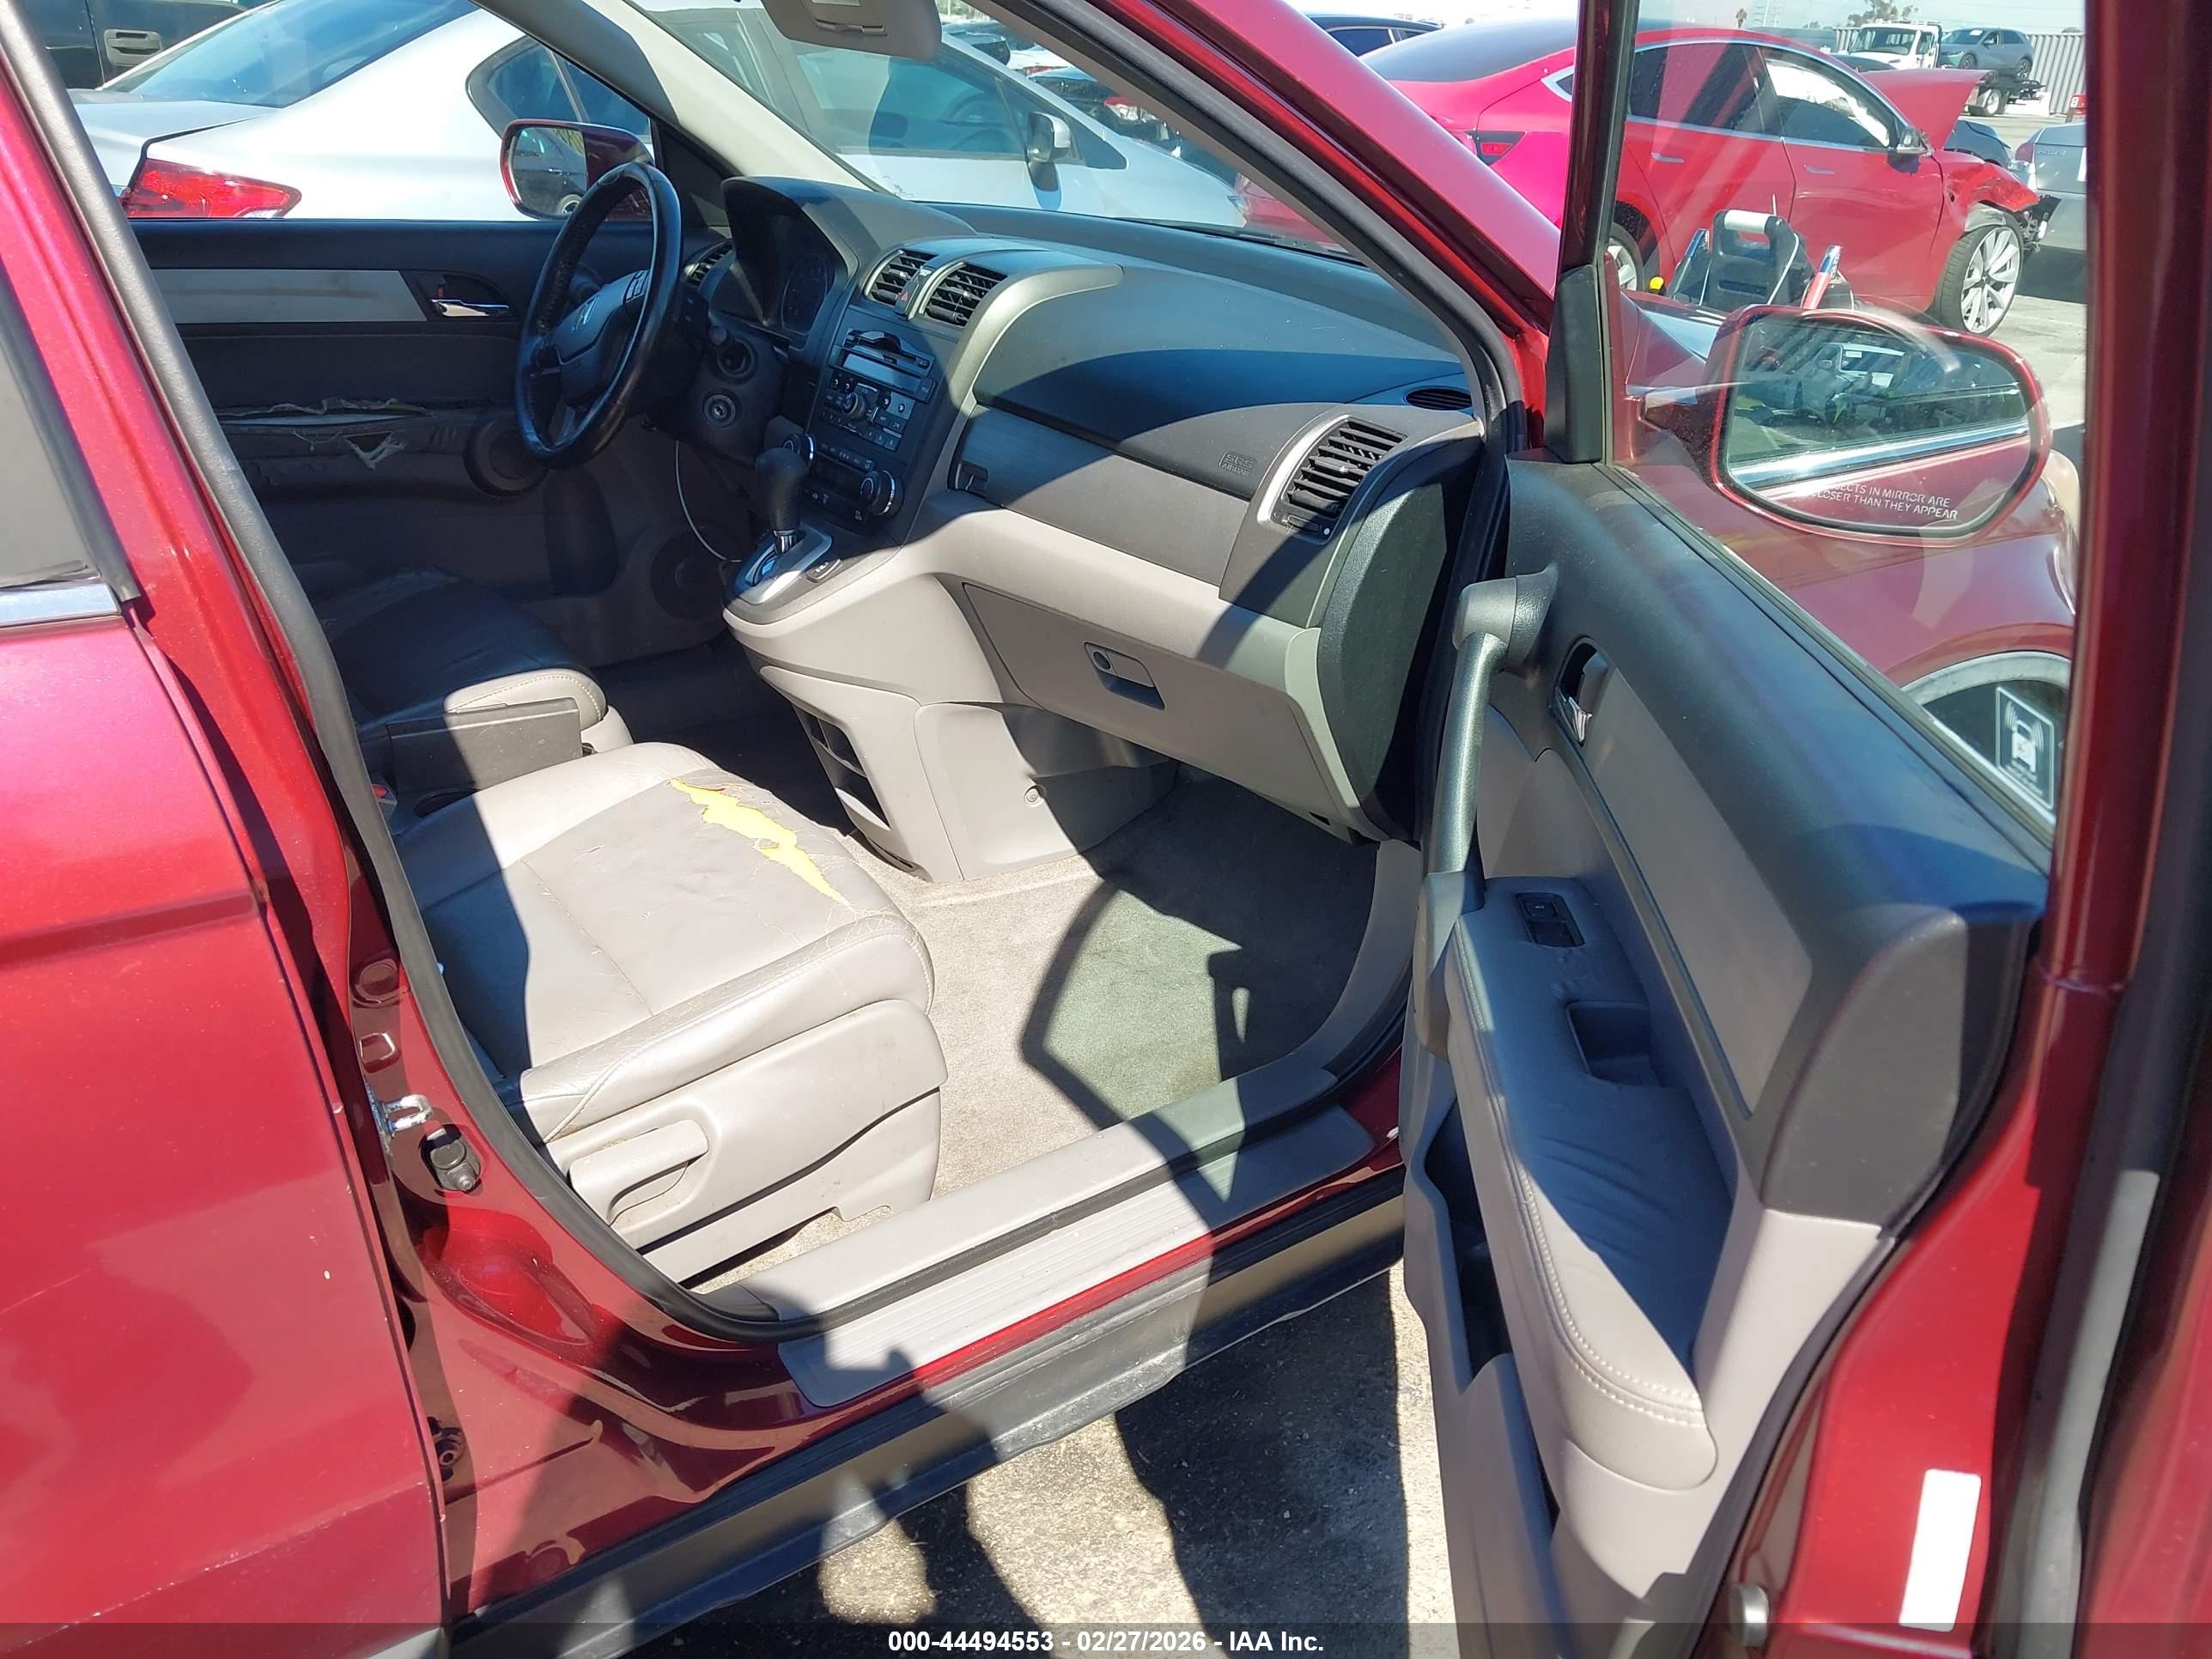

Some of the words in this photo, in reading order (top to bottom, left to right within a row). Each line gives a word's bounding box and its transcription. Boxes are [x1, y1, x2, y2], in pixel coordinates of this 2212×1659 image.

[1853, 494, 1881, 508] THAN
[1884, 499, 1911, 513] THEY
[1912, 504, 1958, 520] APPEAR
[1869, 486, 1881, 496] IN
[1881, 489, 1925, 503] MIRROR
[1927, 495, 1952, 508] ARE
